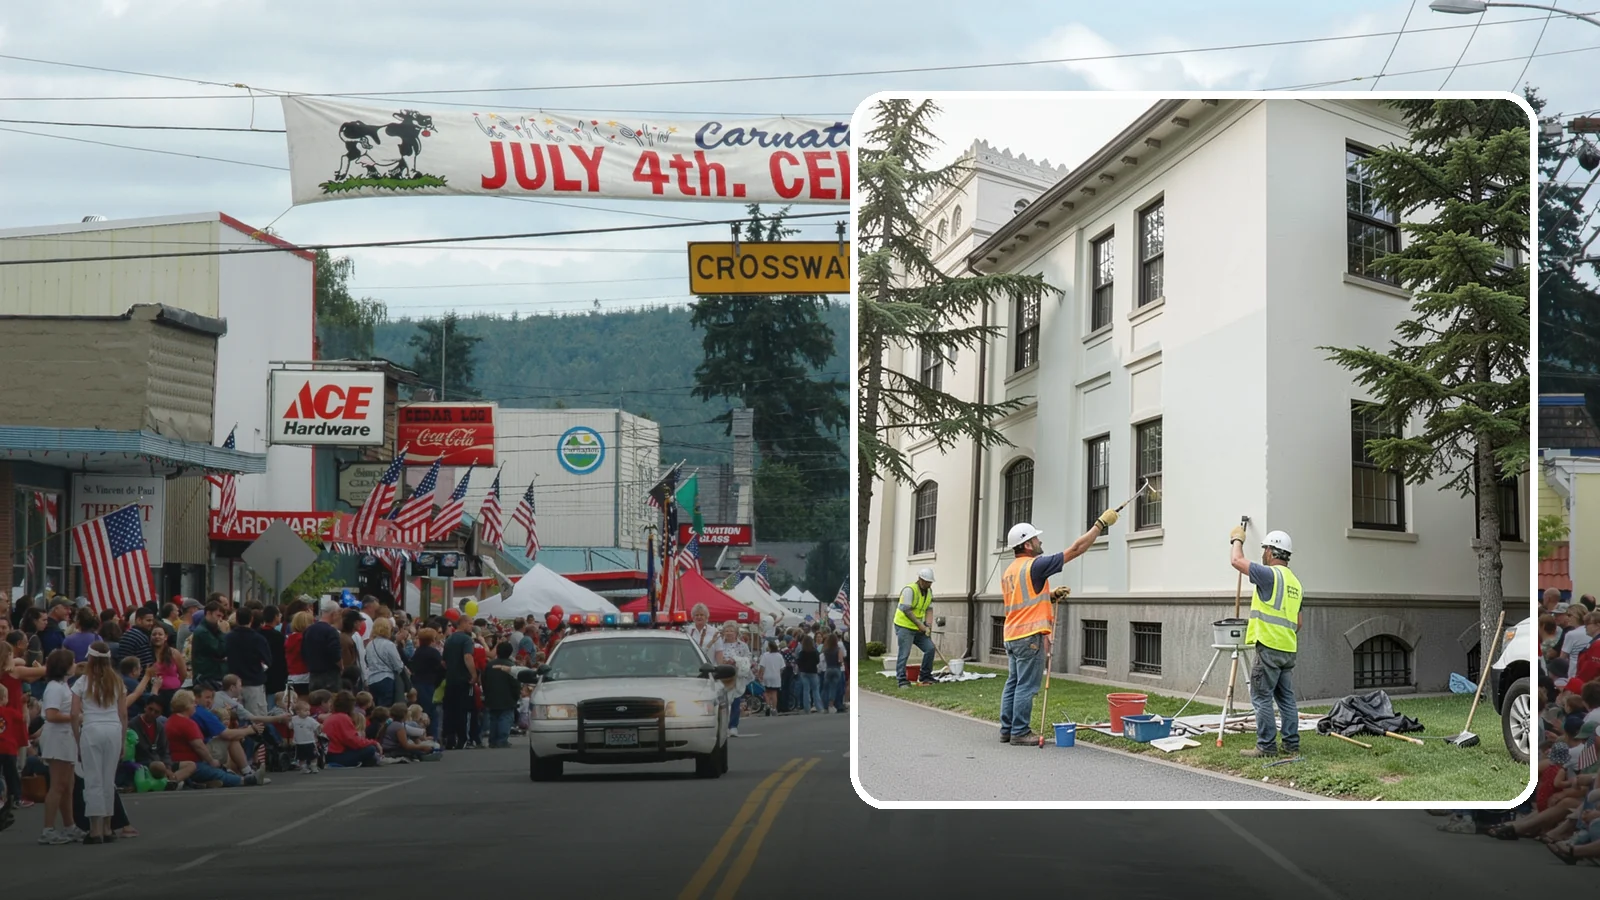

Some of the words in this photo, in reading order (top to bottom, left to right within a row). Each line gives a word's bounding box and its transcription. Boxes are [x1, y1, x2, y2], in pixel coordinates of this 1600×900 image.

[481, 140, 605, 193] JULY
[632, 150, 747, 198] 4th.
[697, 254, 850, 280] CROSSWA
[282, 380, 374, 420] ACE
[406, 409, 453, 423] CEDAR
[461, 409, 486, 422] LOG
[283, 421, 371, 437] Hardware
[416, 428, 477, 447] Coca-Cola
[353, 467, 385, 482] Simpl
[83, 484, 94, 495] St.
[96, 485, 125, 495] Vincent
[126, 486, 136, 495] de
[137, 486, 155, 495] Paul
[688, 526, 741, 535] CRNATION
[699, 535, 730, 543] GLASS
